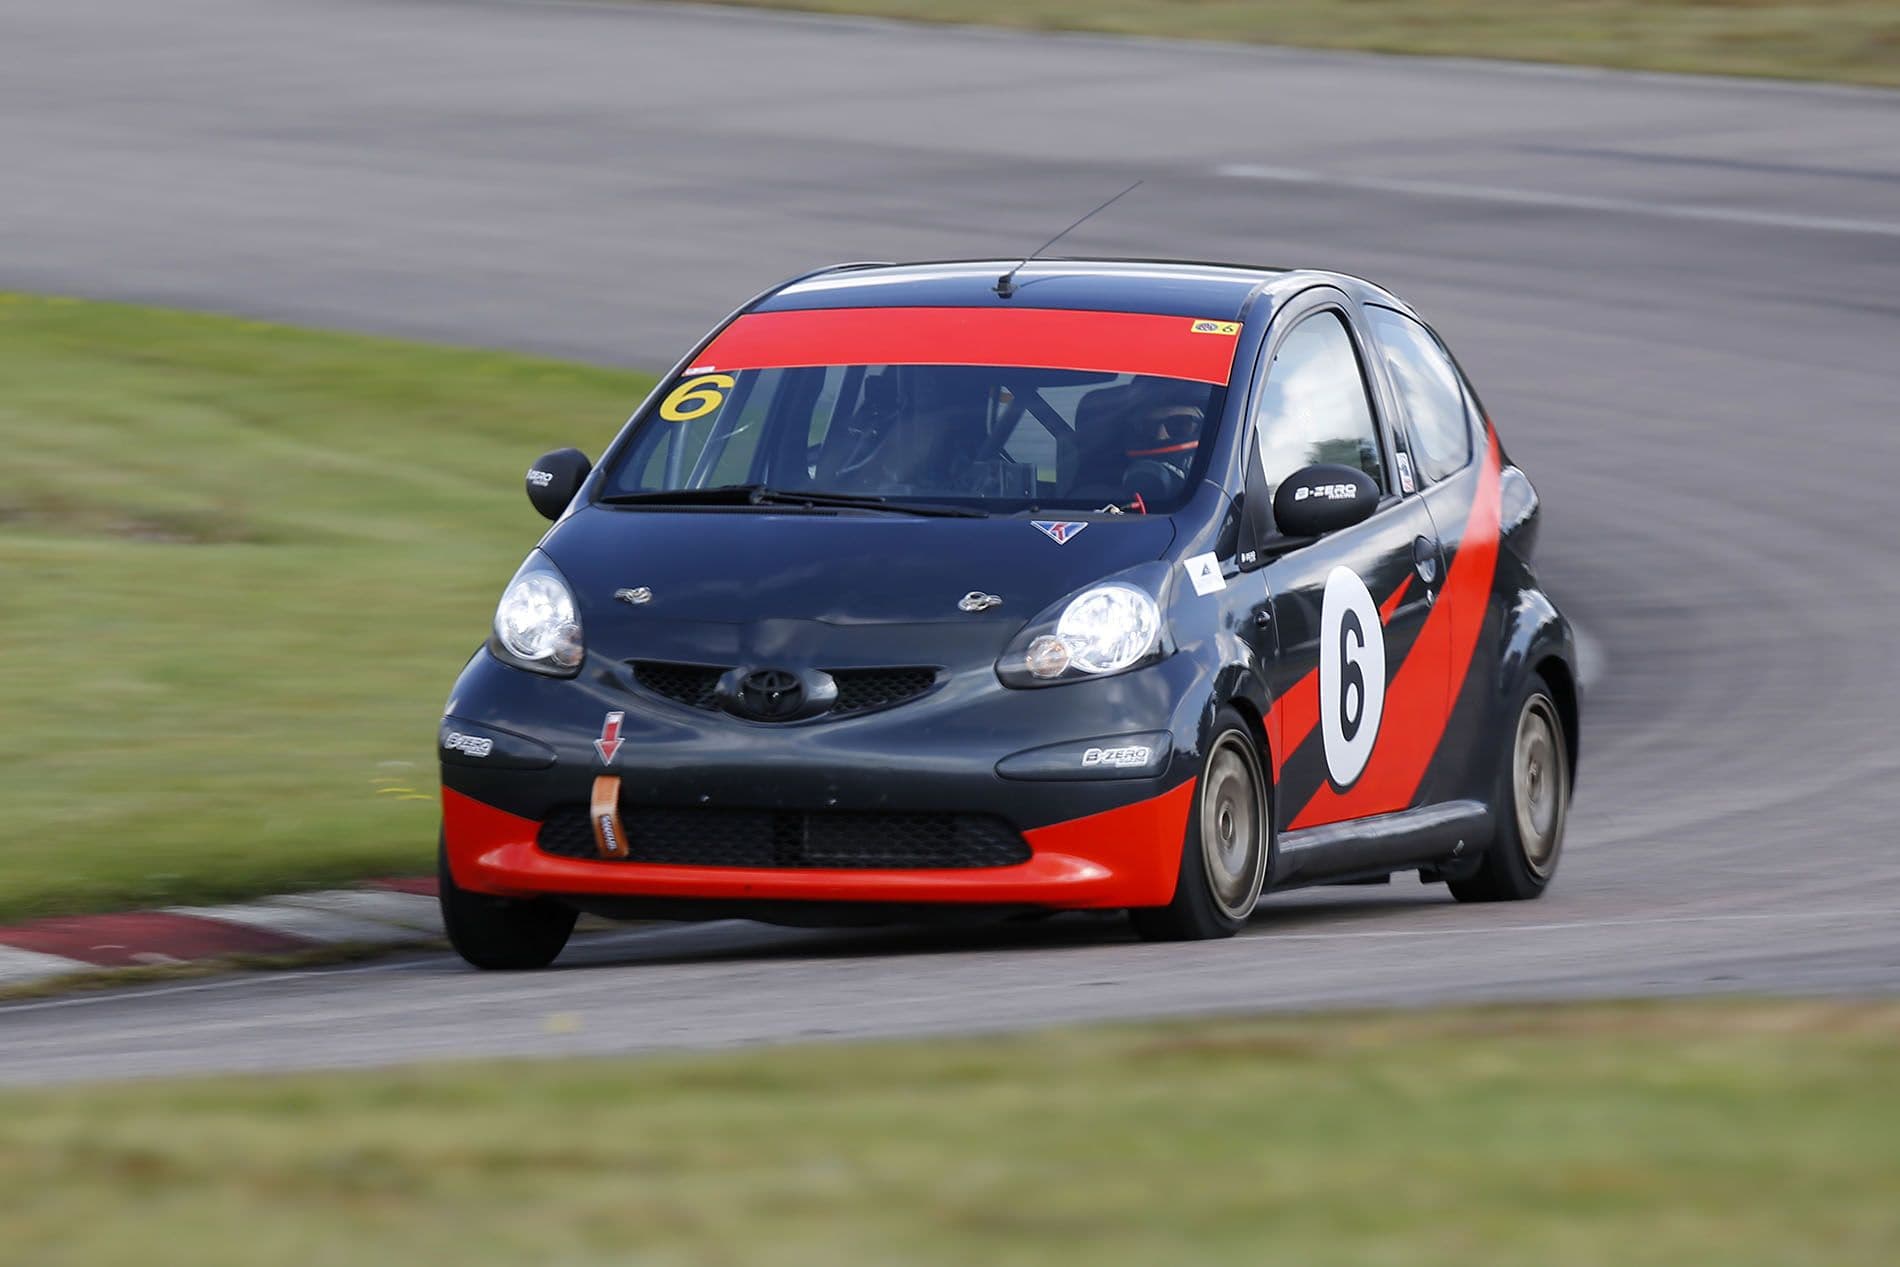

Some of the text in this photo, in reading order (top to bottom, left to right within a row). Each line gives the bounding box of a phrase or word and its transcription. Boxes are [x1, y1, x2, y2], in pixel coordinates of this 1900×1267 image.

[1222, 324, 1234, 333] 6
[659, 374, 735, 422] 6
[1295, 483, 1357, 500] B-ZERO
[1339, 608, 1365, 742] 6
[1084, 747, 1148, 763] B-ZERO
